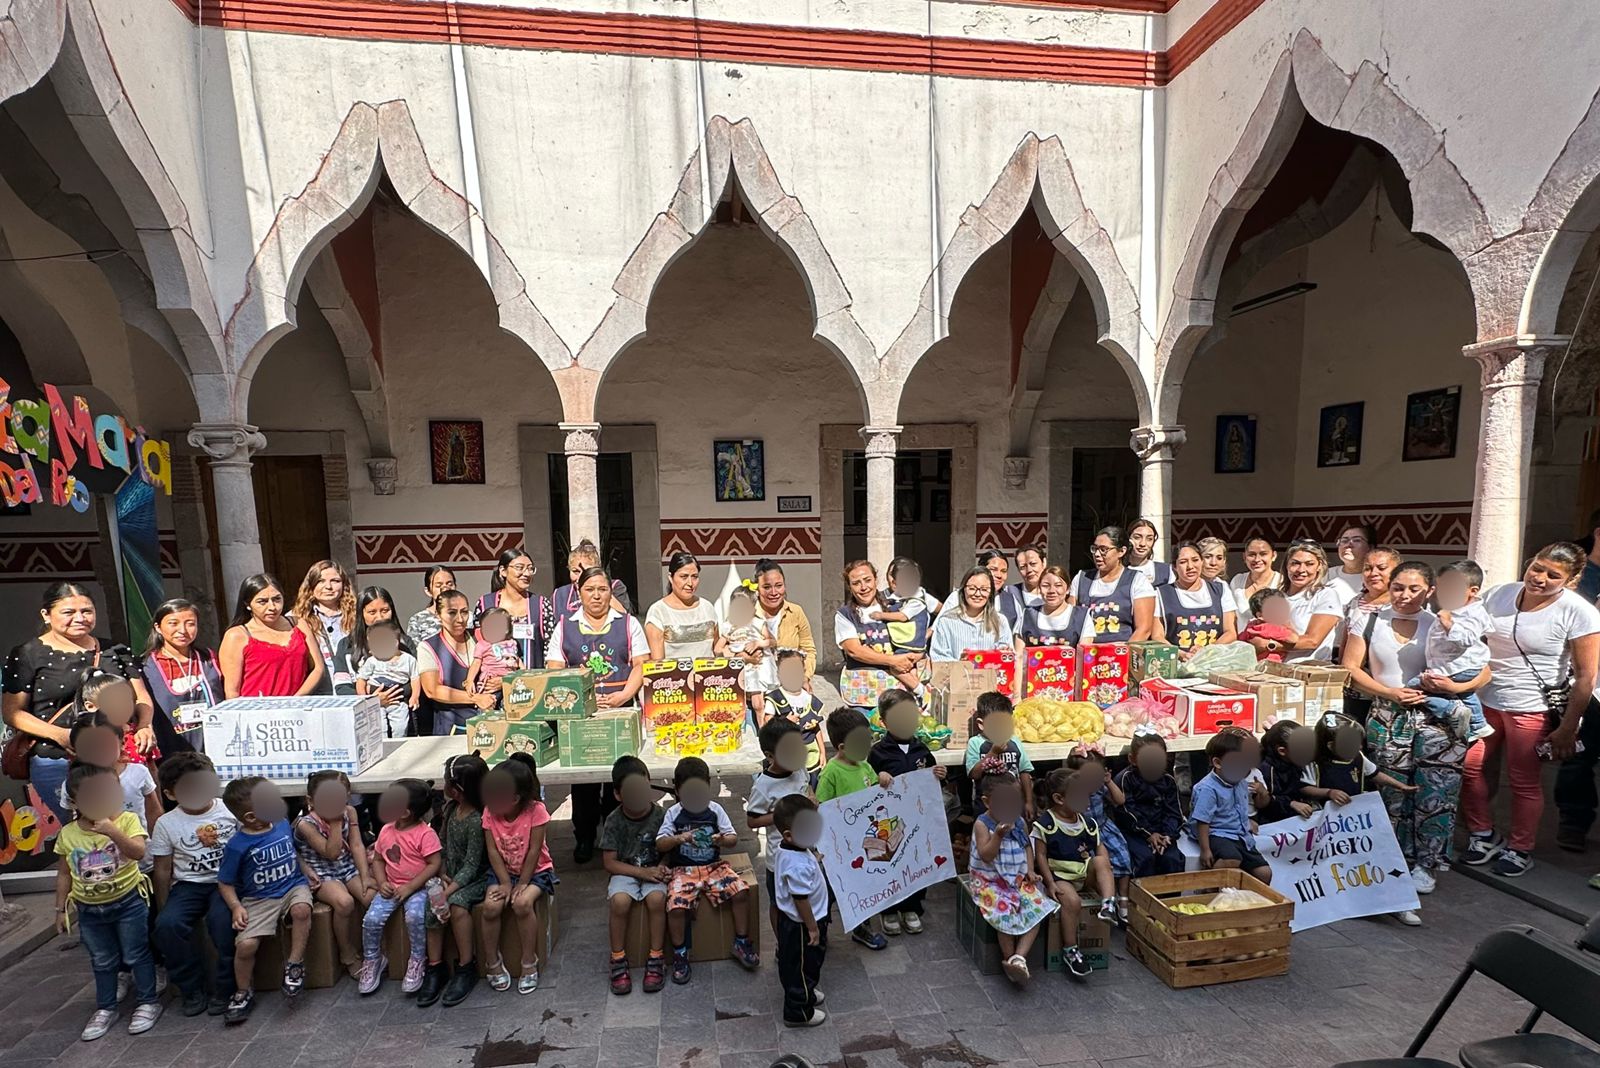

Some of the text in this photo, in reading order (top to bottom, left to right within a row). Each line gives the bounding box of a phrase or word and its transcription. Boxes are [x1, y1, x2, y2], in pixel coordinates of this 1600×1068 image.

[782, 500, 801, 509] SALA
[1041, 673, 1068, 683] LOOPS
[1098, 669, 1121, 680] LOOPS
[509, 689, 535, 704] Nutri
[652, 694, 687, 704] KRISPIS
[703, 692, 738, 702] KRISPIS
[256, 723, 296, 741] San
[472, 734, 496, 747] Nutri
[257, 739, 311, 757] Juan
[1307, 834, 1373, 868] quiero
[1294, 872, 1326, 904] mi
